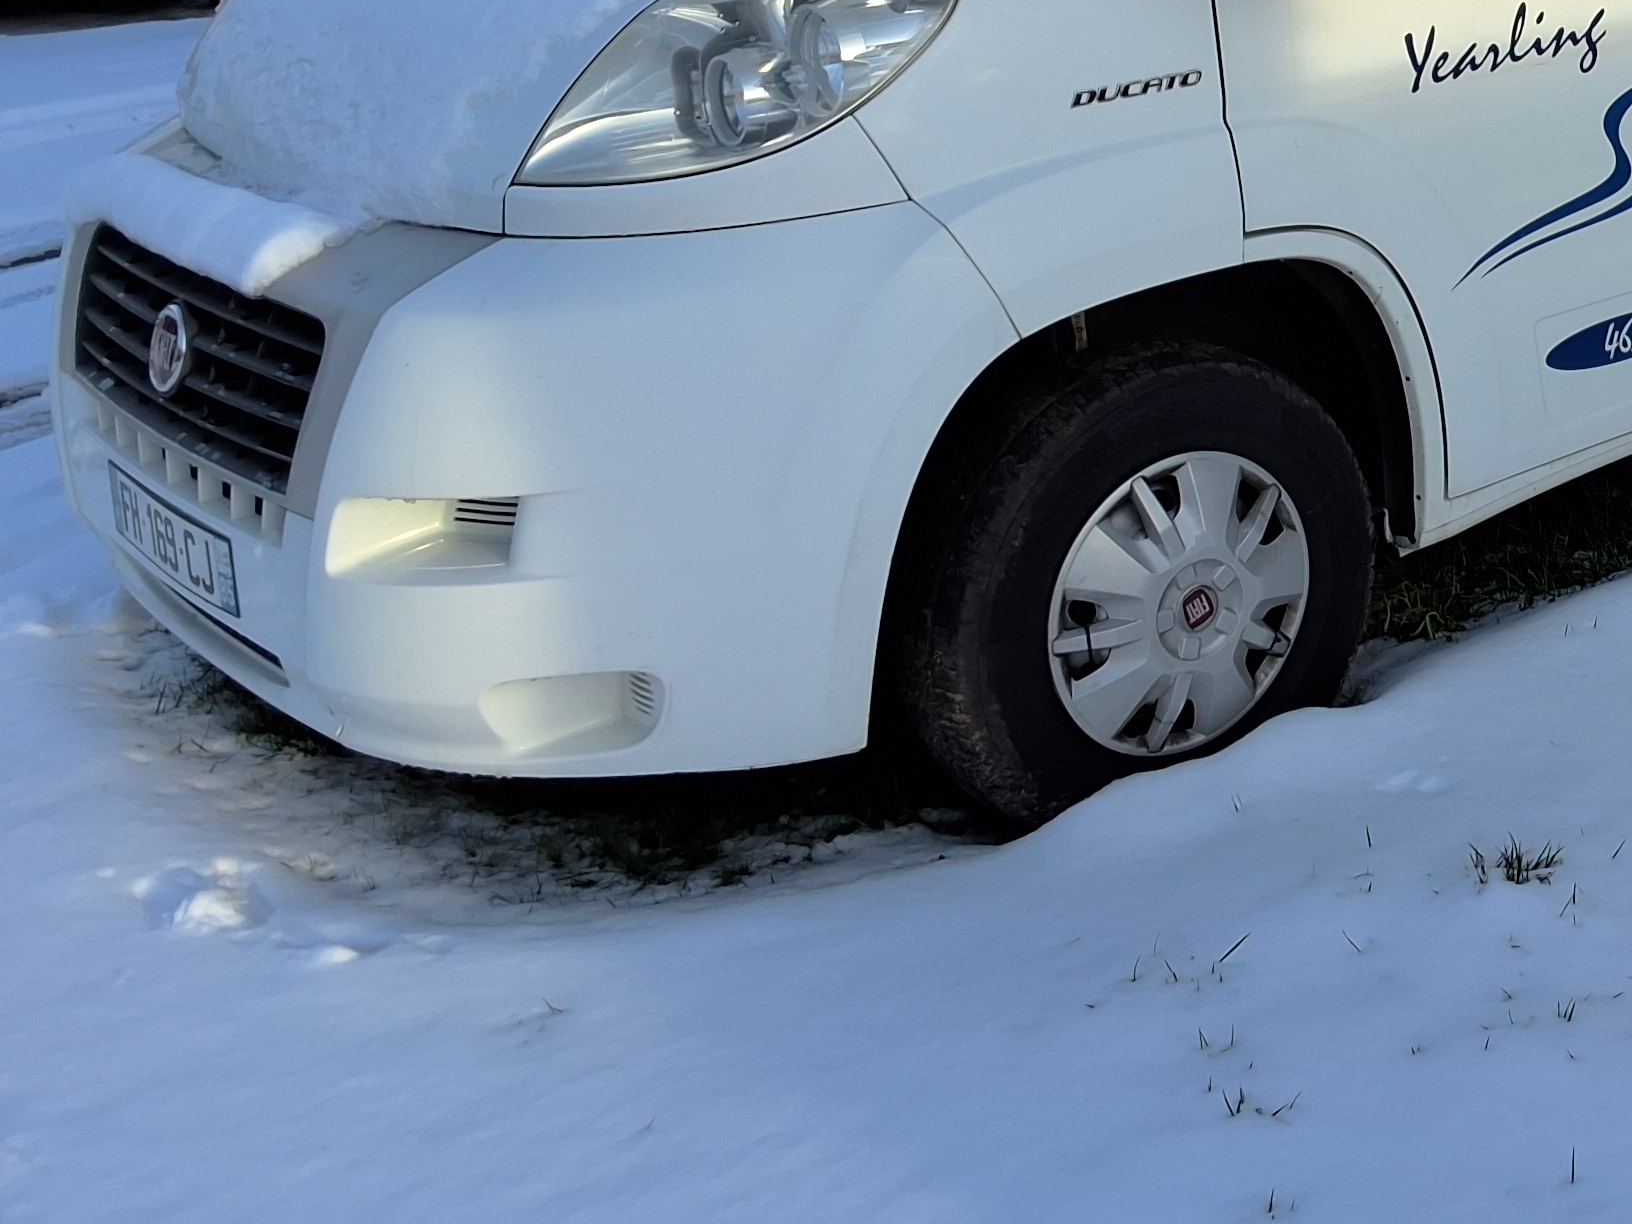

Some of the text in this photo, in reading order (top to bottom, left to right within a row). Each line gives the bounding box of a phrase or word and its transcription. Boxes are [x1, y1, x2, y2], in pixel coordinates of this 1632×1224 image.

[1404, 2, 1607, 94] Yearling
[1071, 69, 1202, 108] DUCATO
[1185, 593, 1210, 624] FIAT
